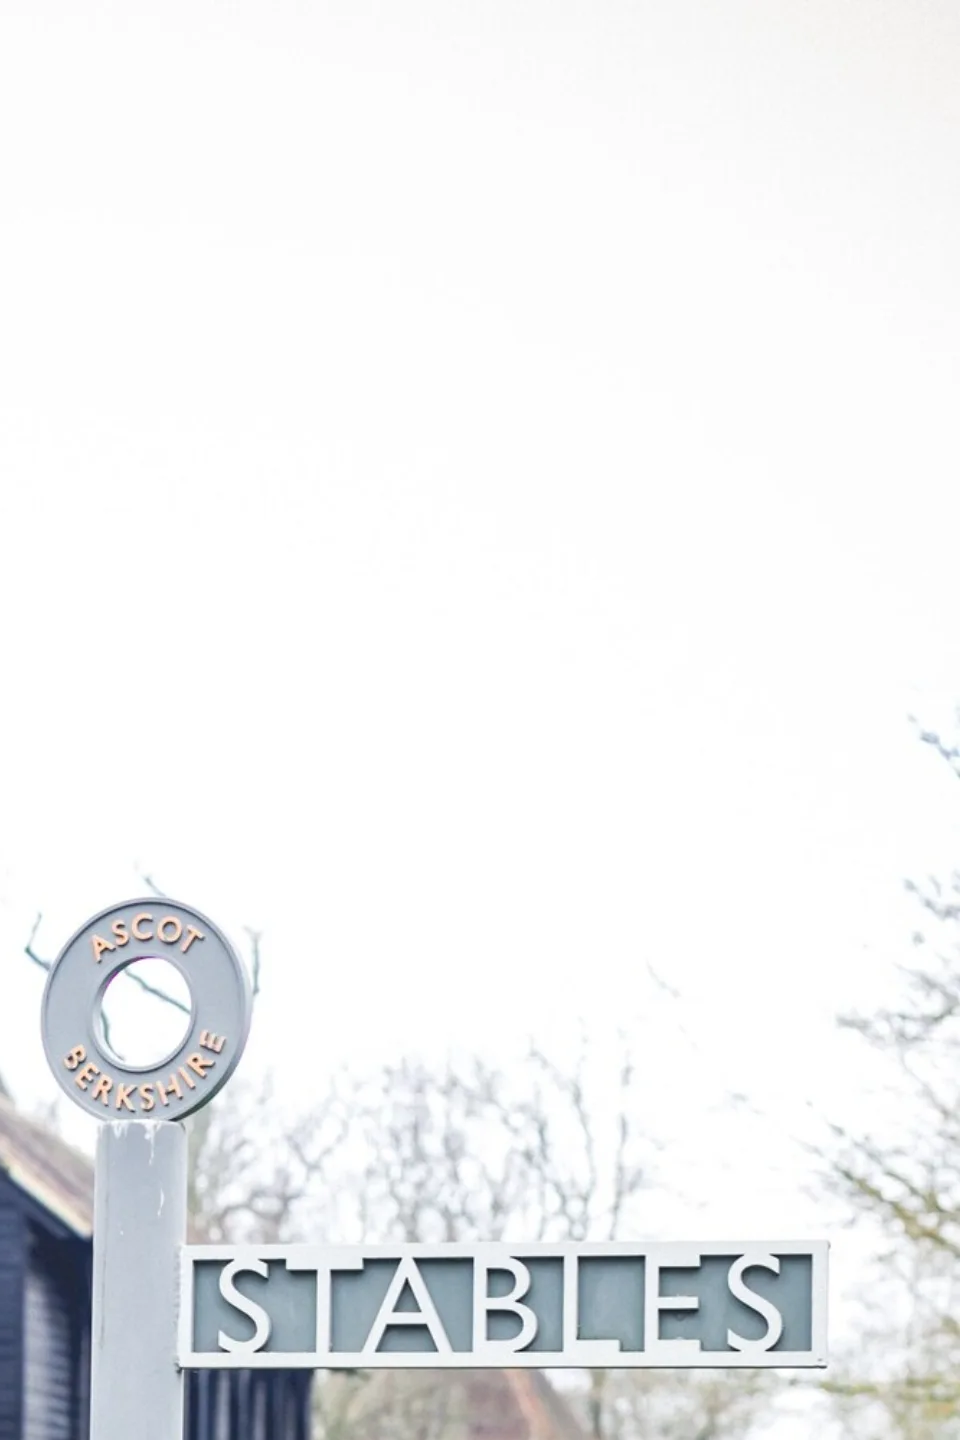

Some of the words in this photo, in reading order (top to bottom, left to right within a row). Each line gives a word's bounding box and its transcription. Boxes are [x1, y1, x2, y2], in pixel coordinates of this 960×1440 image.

[92, 912, 205, 963] ASCOT
[63, 1029, 226, 1113] BERKSHIRE
[217, 1254, 783, 1354] STABLES
